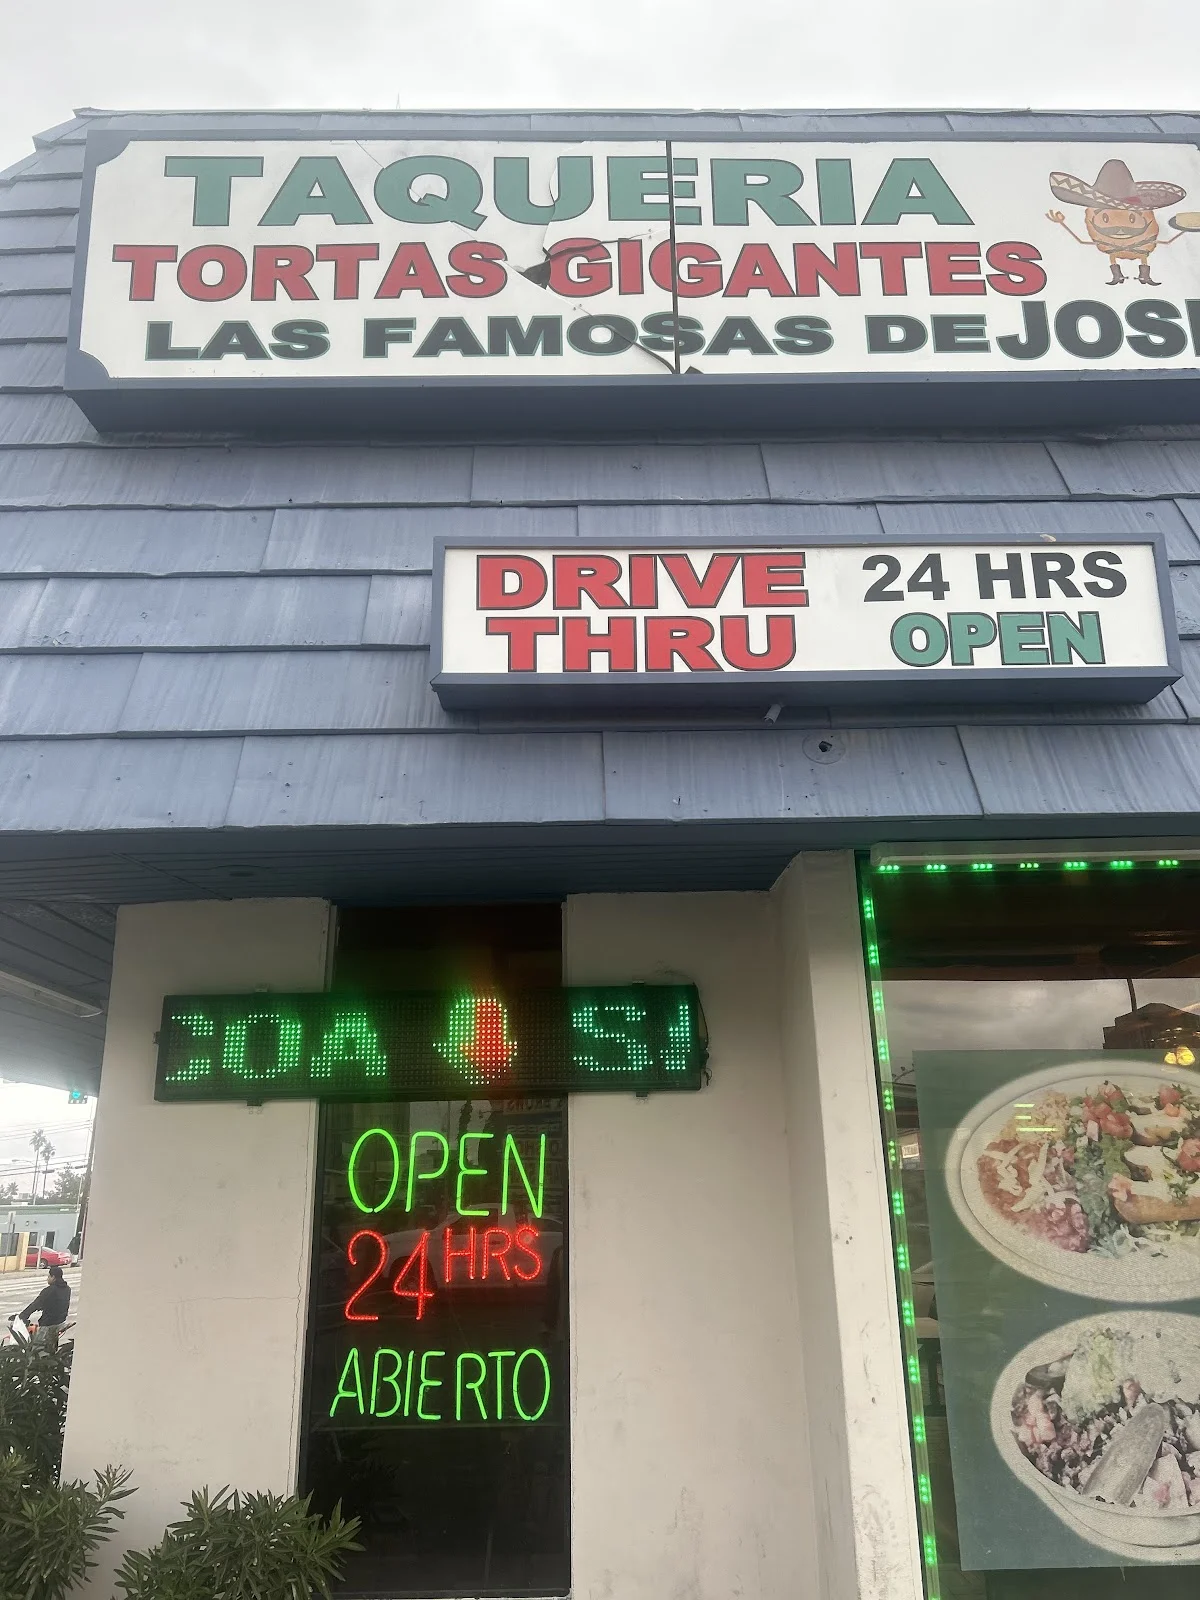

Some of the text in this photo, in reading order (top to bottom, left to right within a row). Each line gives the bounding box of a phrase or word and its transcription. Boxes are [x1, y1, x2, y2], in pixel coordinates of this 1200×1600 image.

[164, 155, 975, 231] TAQUERIA
[112, 238, 1048, 302] TORTAS GIGANTES
[145, 318, 331, 361] LAS
[363, 312, 834, 358] FAMOSAS
[865, 314, 991, 354] DE
[476, 551, 810, 611] DRIVE
[862, 550, 1128, 602] 24 HRS
[485, 614, 797, 673] THRU
[890, 611, 1107, 667] OPEN
[348, 1128, 546, 1218] OPEN
[345, 1226, 542, 1320] 24 HRS
[329, 1347, 551, 1421] ABIERTO
